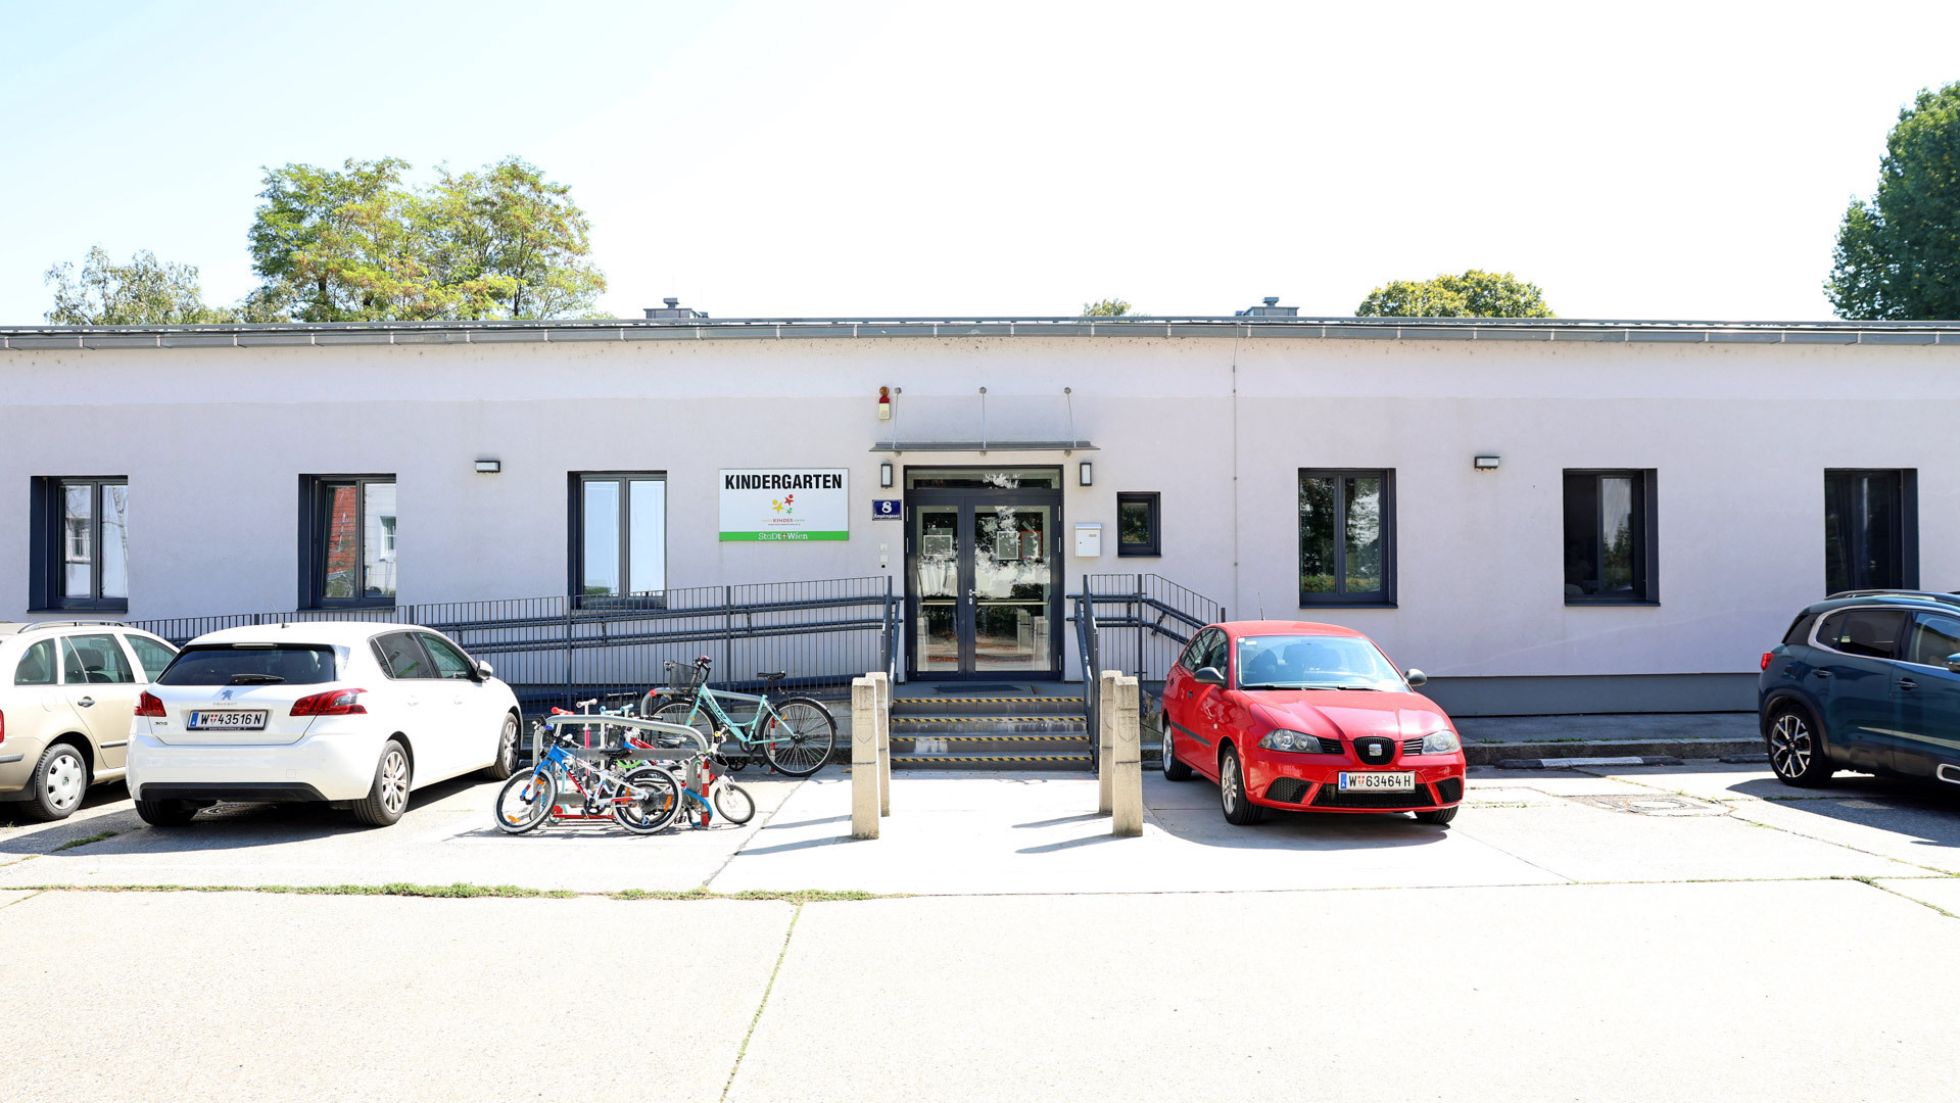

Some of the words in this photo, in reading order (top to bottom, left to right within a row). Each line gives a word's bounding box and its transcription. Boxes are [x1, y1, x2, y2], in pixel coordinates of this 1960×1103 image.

[725, 474, 842, 490] KINDERGARTEN
[881, 501, 892, 513] 8
[201, 714, 210, 725] W
[1349, 775, 1357, 787] W
[1366, 775, 1401, 787] 63464
